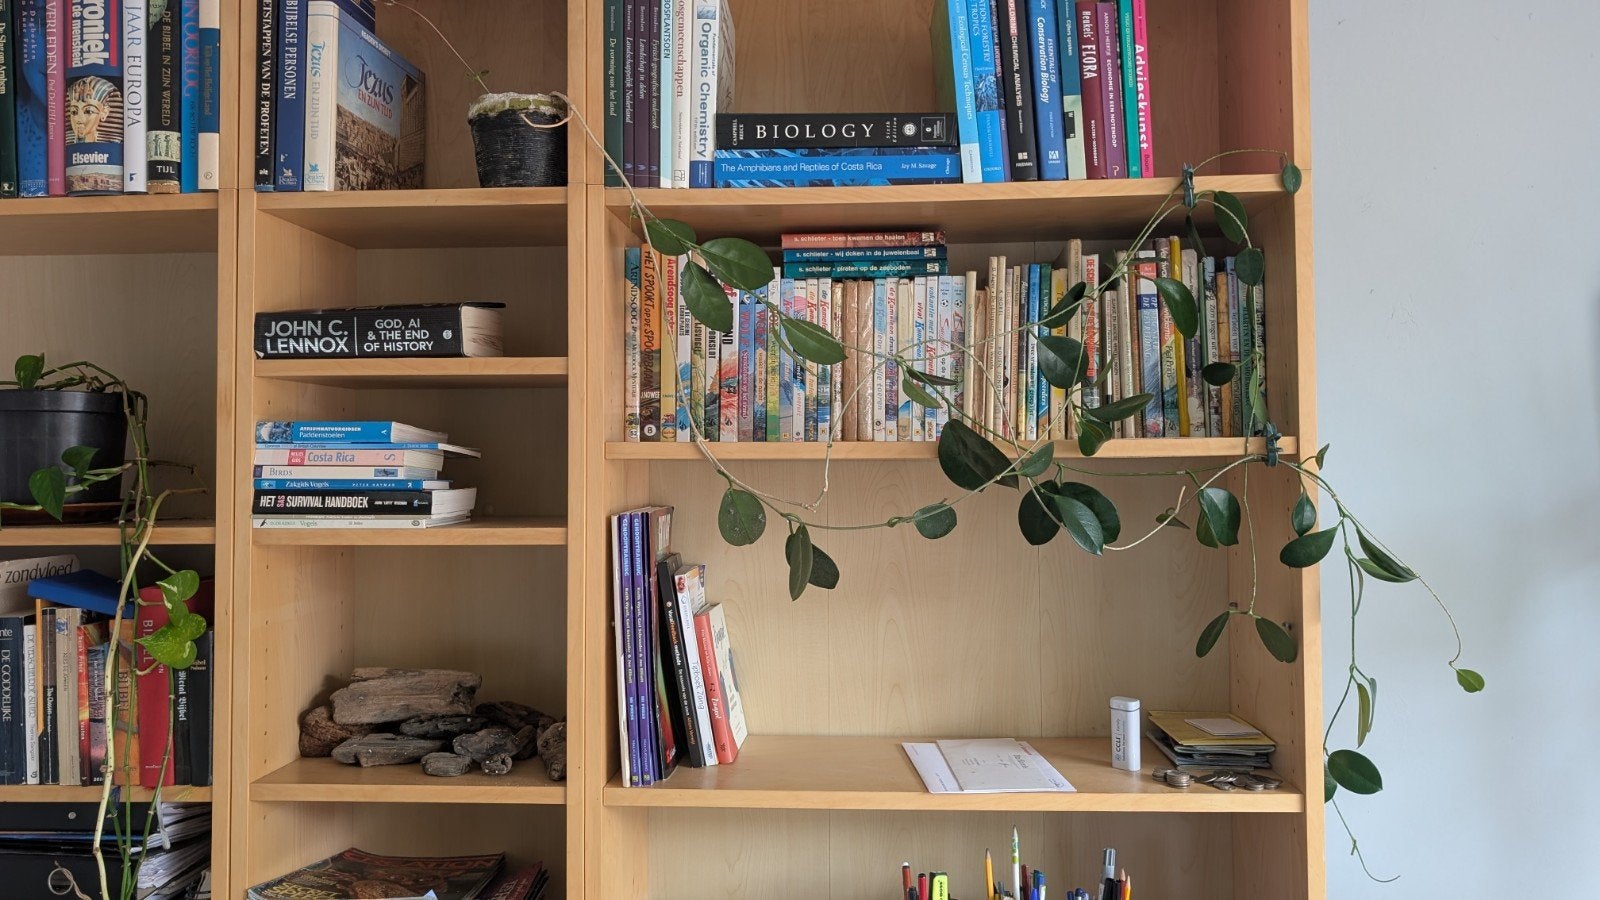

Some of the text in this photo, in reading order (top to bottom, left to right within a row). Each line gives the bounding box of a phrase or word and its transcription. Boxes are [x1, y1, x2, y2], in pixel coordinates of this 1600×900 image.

[0, 23, 6, 35] De
[72, 5, 82, 67] de mensheid
[957, 16, 968, 51] Ecological
[971, 3, 980, 36] TROPICS
[46, 1, 57, 74] VERLEDEN
[284, 0, 298, 99] BIJBELSE PERSONEN
[610, 38, 616, 48] De
[674, 0, 687, 97] osgemeenschappen
[699, 22, 711, 77] Organic
[982, 25, 992, 62] FORESTRY
[1037, 17, 1049, 71] Conservation
[1082, 11, 1097, 79] Heukels' FLORA
[0, 52, 6, 63] om
[125, 6, 141, 127] JAAR EUROPA
[162, 11, 171, 126] DE BIJBEL IN ZIJN WERELD
[185, 22, 199, 96] OORLOG
[608, 49, 617, 76] vorming
[638, 38, 646, 73] Landschap
[961, 53, 970, 78] Census
[1011, 36, 1023, 107] CHEMICAL ANALYSIS
[1047, 38, 1056, 83] ESSENTIALS OF
[310, 41, 325, 139] Jezus EN ZIJN TIJD
[1040, 72, 1051, 103] Biology
[1106, 59, 1114, 91] ECONOMIE
[259, 60, 271, 155] VAN DE PROFETEN
[963, 80, 974, 120] Techniques
[1134, 44, 1149, 149] Advieskunst
[697, 83, 710, 158] Chemistry
[756, 123, 874, 139] BIOLOGY
[73, 152, 109, 164] Elsevier
[721, 162, 883, 174] The Amphibians and Reptiles of Costa Rica
[901, 162, 909, 171] Jay
[918, 162, 937, 171] Savage
[666, 258, 677, 309] Arendsoog
[837, 265, 859, 273] piraten
[879, 264, 912, 272] zeebodem
[630, 263, 639, 325] ARENDSOOG
[821, 290, 828, 299] de
[887, 287, 896, 335] de Kameleon
[1151, 297, 1158, 308] OP
[265, 320, 349, 337] JOHN C.
[367, 330, 429, 341] & THE END
[375, 318, 420, 330] GOD, AI
[643, 251, 655, 388] HET SPOOKT OP DE SPOORBAAN
[1142, 297, 1152, 358] DE BEVRIJDING
[1162, 308, 1173, 340] wildernis
[1209, 320, 1217, 340] jongen
[266, 337, 349, 354] LENNOX
[363, 341, 434, 352] OF HISTORY
[1165, 346, 1175, 378] Piet Prins
[307, 452, 333, 463] Costa
[335, 451, 355, 463] Rica
[260, 495, 369, 508] HET SAS SURVIVAL HANDBOEK
[285, 481, 330, 489] Zakgids Vogels
[5, 560, 74, 585] zondvloed
[667, 610, 682, 666] VocalFeedback methode
[1, 650, 11, 722] DE GODDELIJKE
[46, 687, 54, 715] The Chosen
[177, 670, 187, 721] Metal Bijbel
[691, 661, 707, 710] Tipboek Zang
